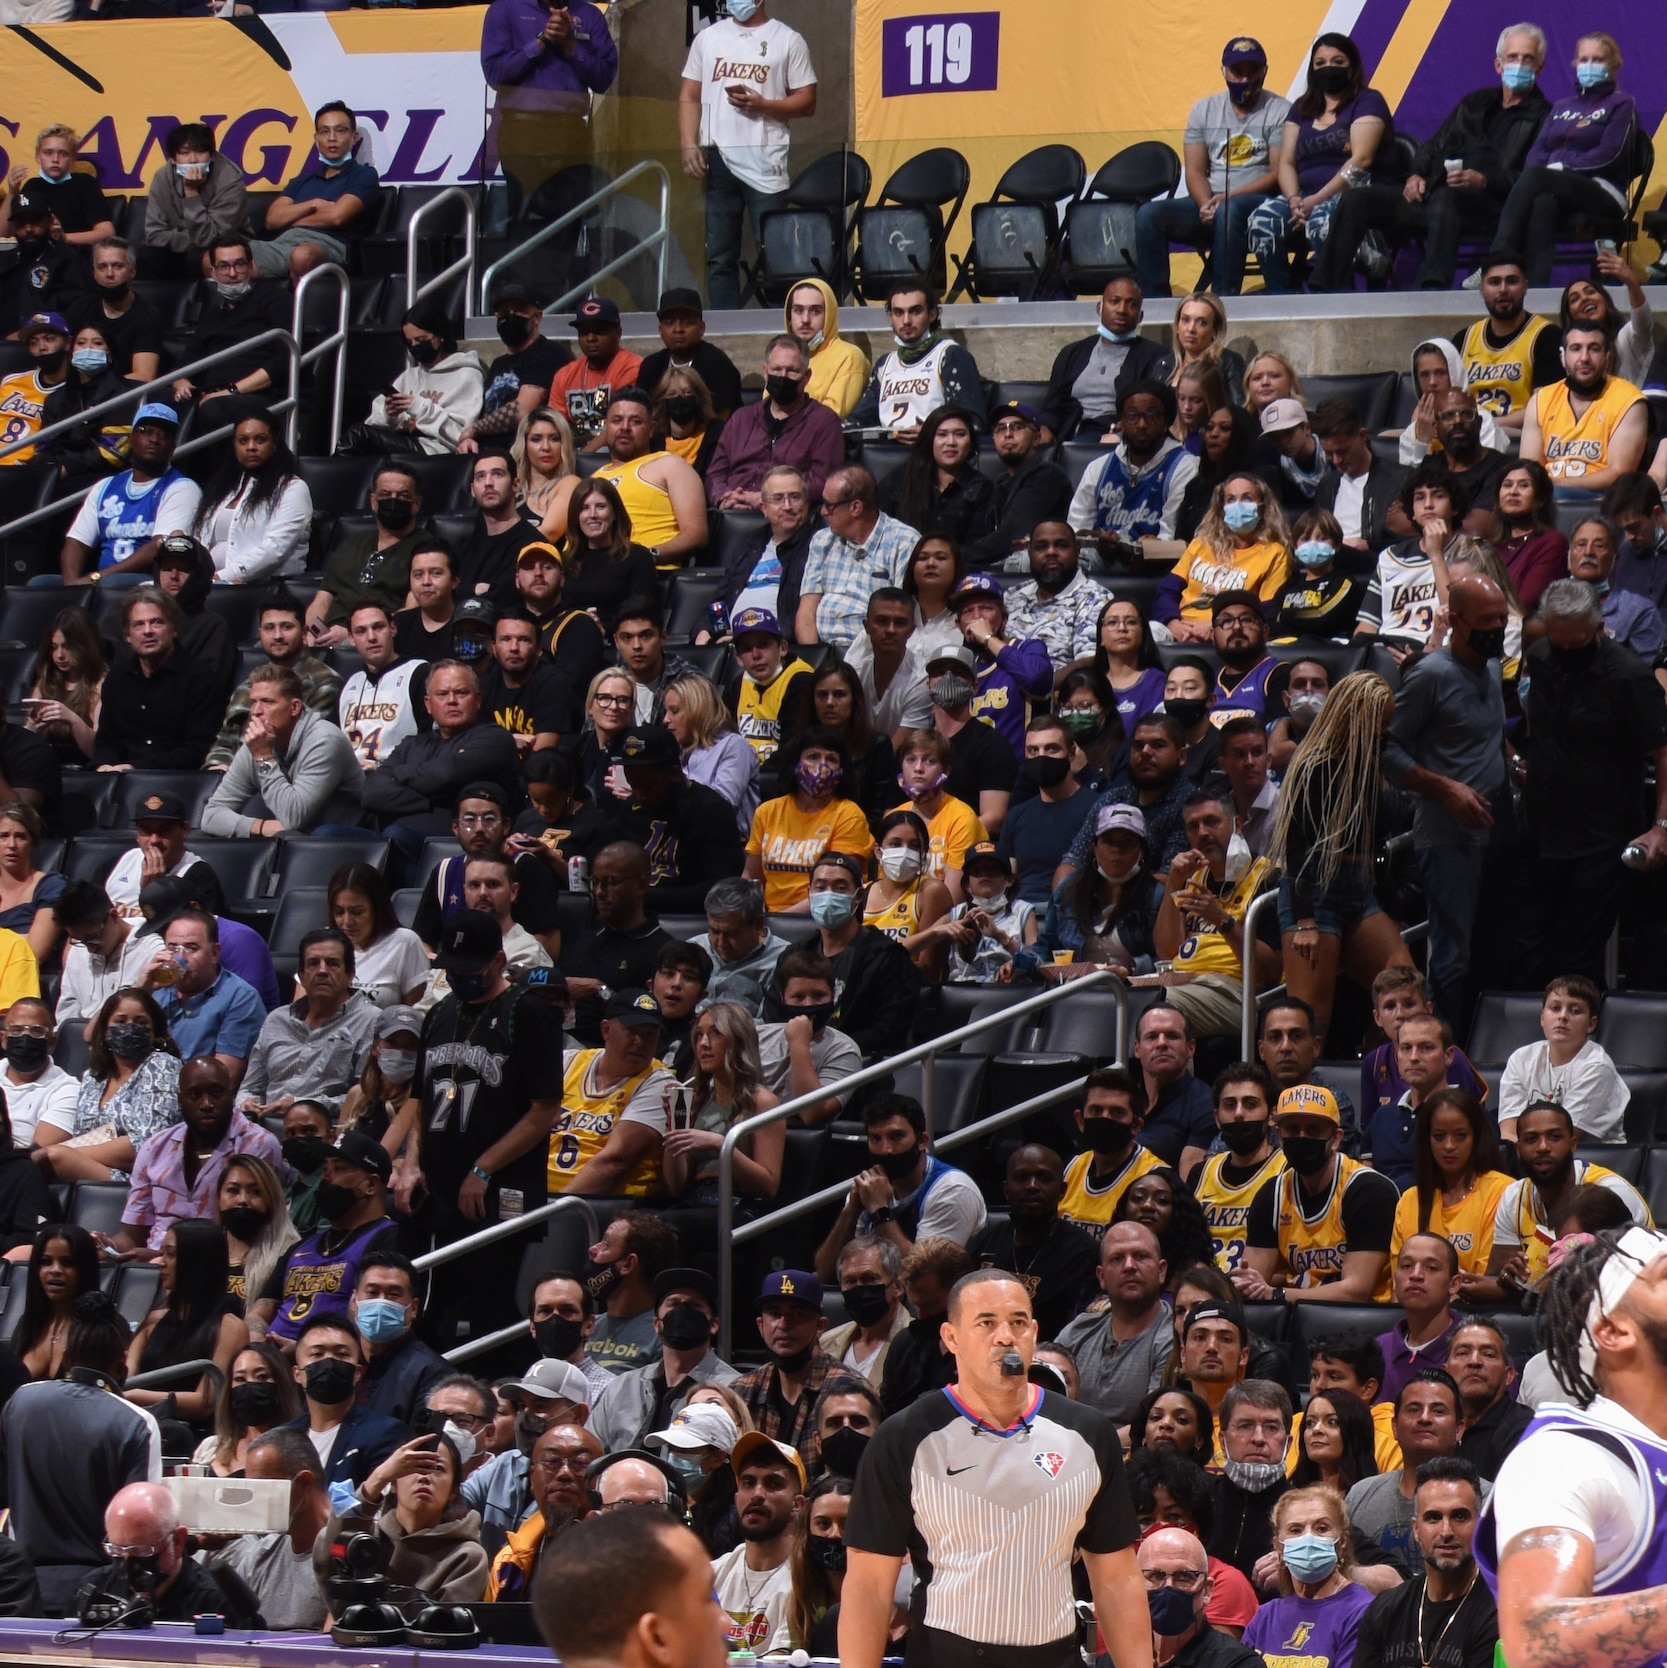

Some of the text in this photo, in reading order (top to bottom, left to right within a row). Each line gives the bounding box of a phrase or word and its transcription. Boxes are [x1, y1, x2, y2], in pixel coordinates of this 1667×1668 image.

[905, 23, 971, 85] 119
[713, 58, 770, 83] LAKERS
[1102, 217, 1117, 250] 4
[581, 301, 600, 316] C
[1467, 361, 1523, 383] LAKERS
[881, 378, 932, 402] LAKERS
[2, 391, 44, 420] LAKER
[1477, 389, 1511, 418] 23
[1, 417, 28, 443] 8
[1547, 436, 1601, 461] LAKERS
[98, 495, 125, 518] Los
[1100, 483, 1126, 508] Los
[1105, 504, 1161, 527] Angeles
[1190, 557, 1248, 590] LAKERS
[345, 702, 398, 727] LAKERS
[762, 832, 826, 865] LAKERS
[431, 1078, 481, 1132] 21
[1281, 1087, 1324, 1108] LAKERS
[555, 1133, 580, 1168] 6
[1198, 1203, 1247, 1228] LAKER
[1288, 1242, 1347, 1271] LAKERS
[286, 1268, 342, 1296] LAKERS
[780, 1275, 794, 1294] LA
